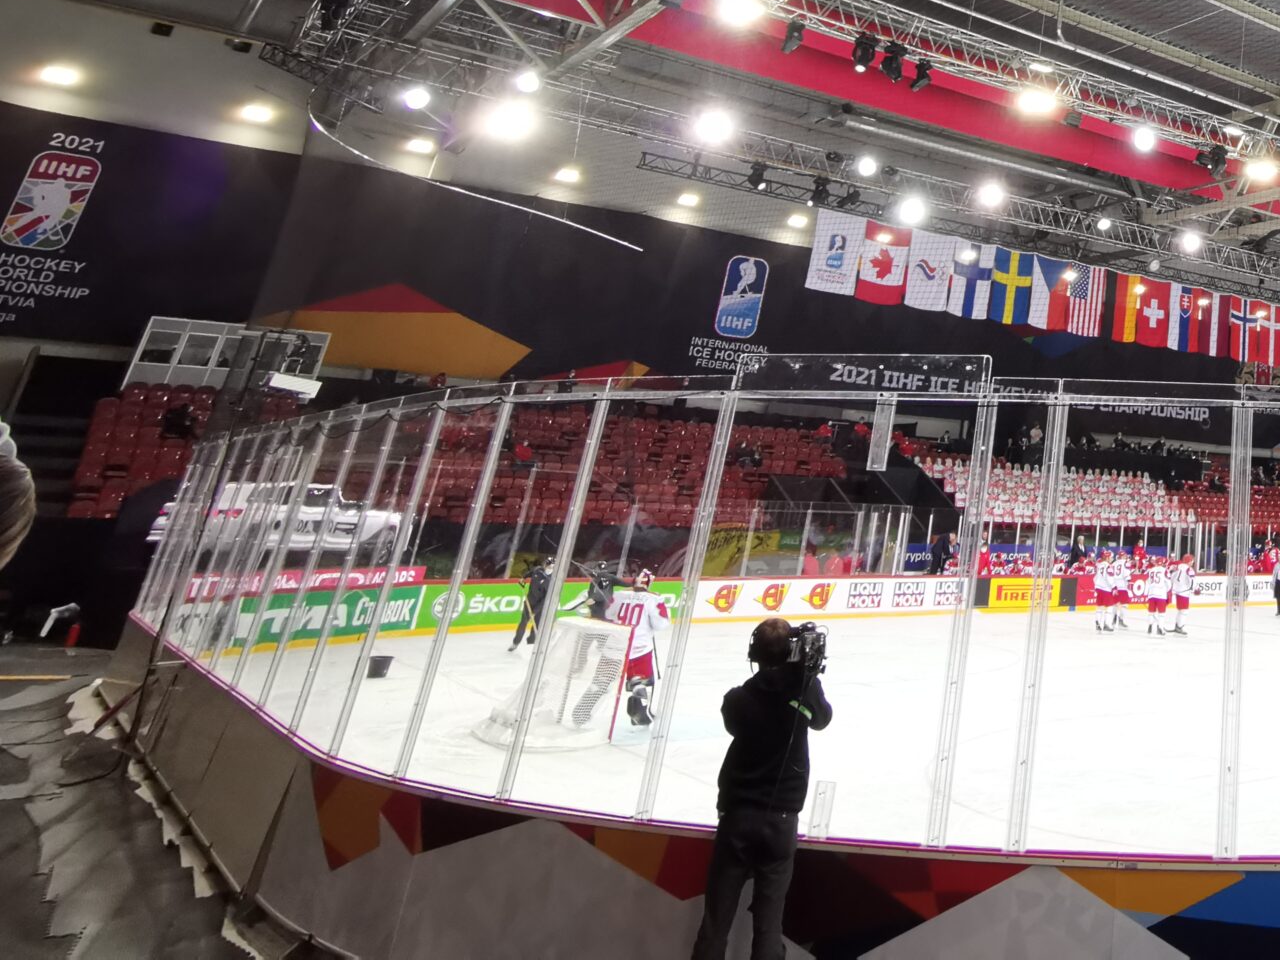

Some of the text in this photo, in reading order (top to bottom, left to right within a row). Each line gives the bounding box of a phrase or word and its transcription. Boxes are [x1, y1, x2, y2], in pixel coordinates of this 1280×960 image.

[49, 132, 105, 153] 2021
[38, 159, 93, 178] IIHF
[0, 252, 86, 273] HOCKEY
[720, 315, 753, 330] IIHF
[691, 336, 769, 354] INTERNATIONAL
[689, 345, 768, 367] ICE HOCKEY
[829, 366, 877, 386] 2021
[882, 370, 925, 391] IIHF
[929, 377, 960, 394] ICE
[906, 552, 931, 562] rypto
[850, 583, 882, 595] LIQUI
[895, 582, 924, 594] LIQUI
[848, 596, 881, 607] MOLY
[893, 595, 924, 607] MOLY
[352, 597, 416, 626] Ствок
[617, 602, 645, 627] 40
